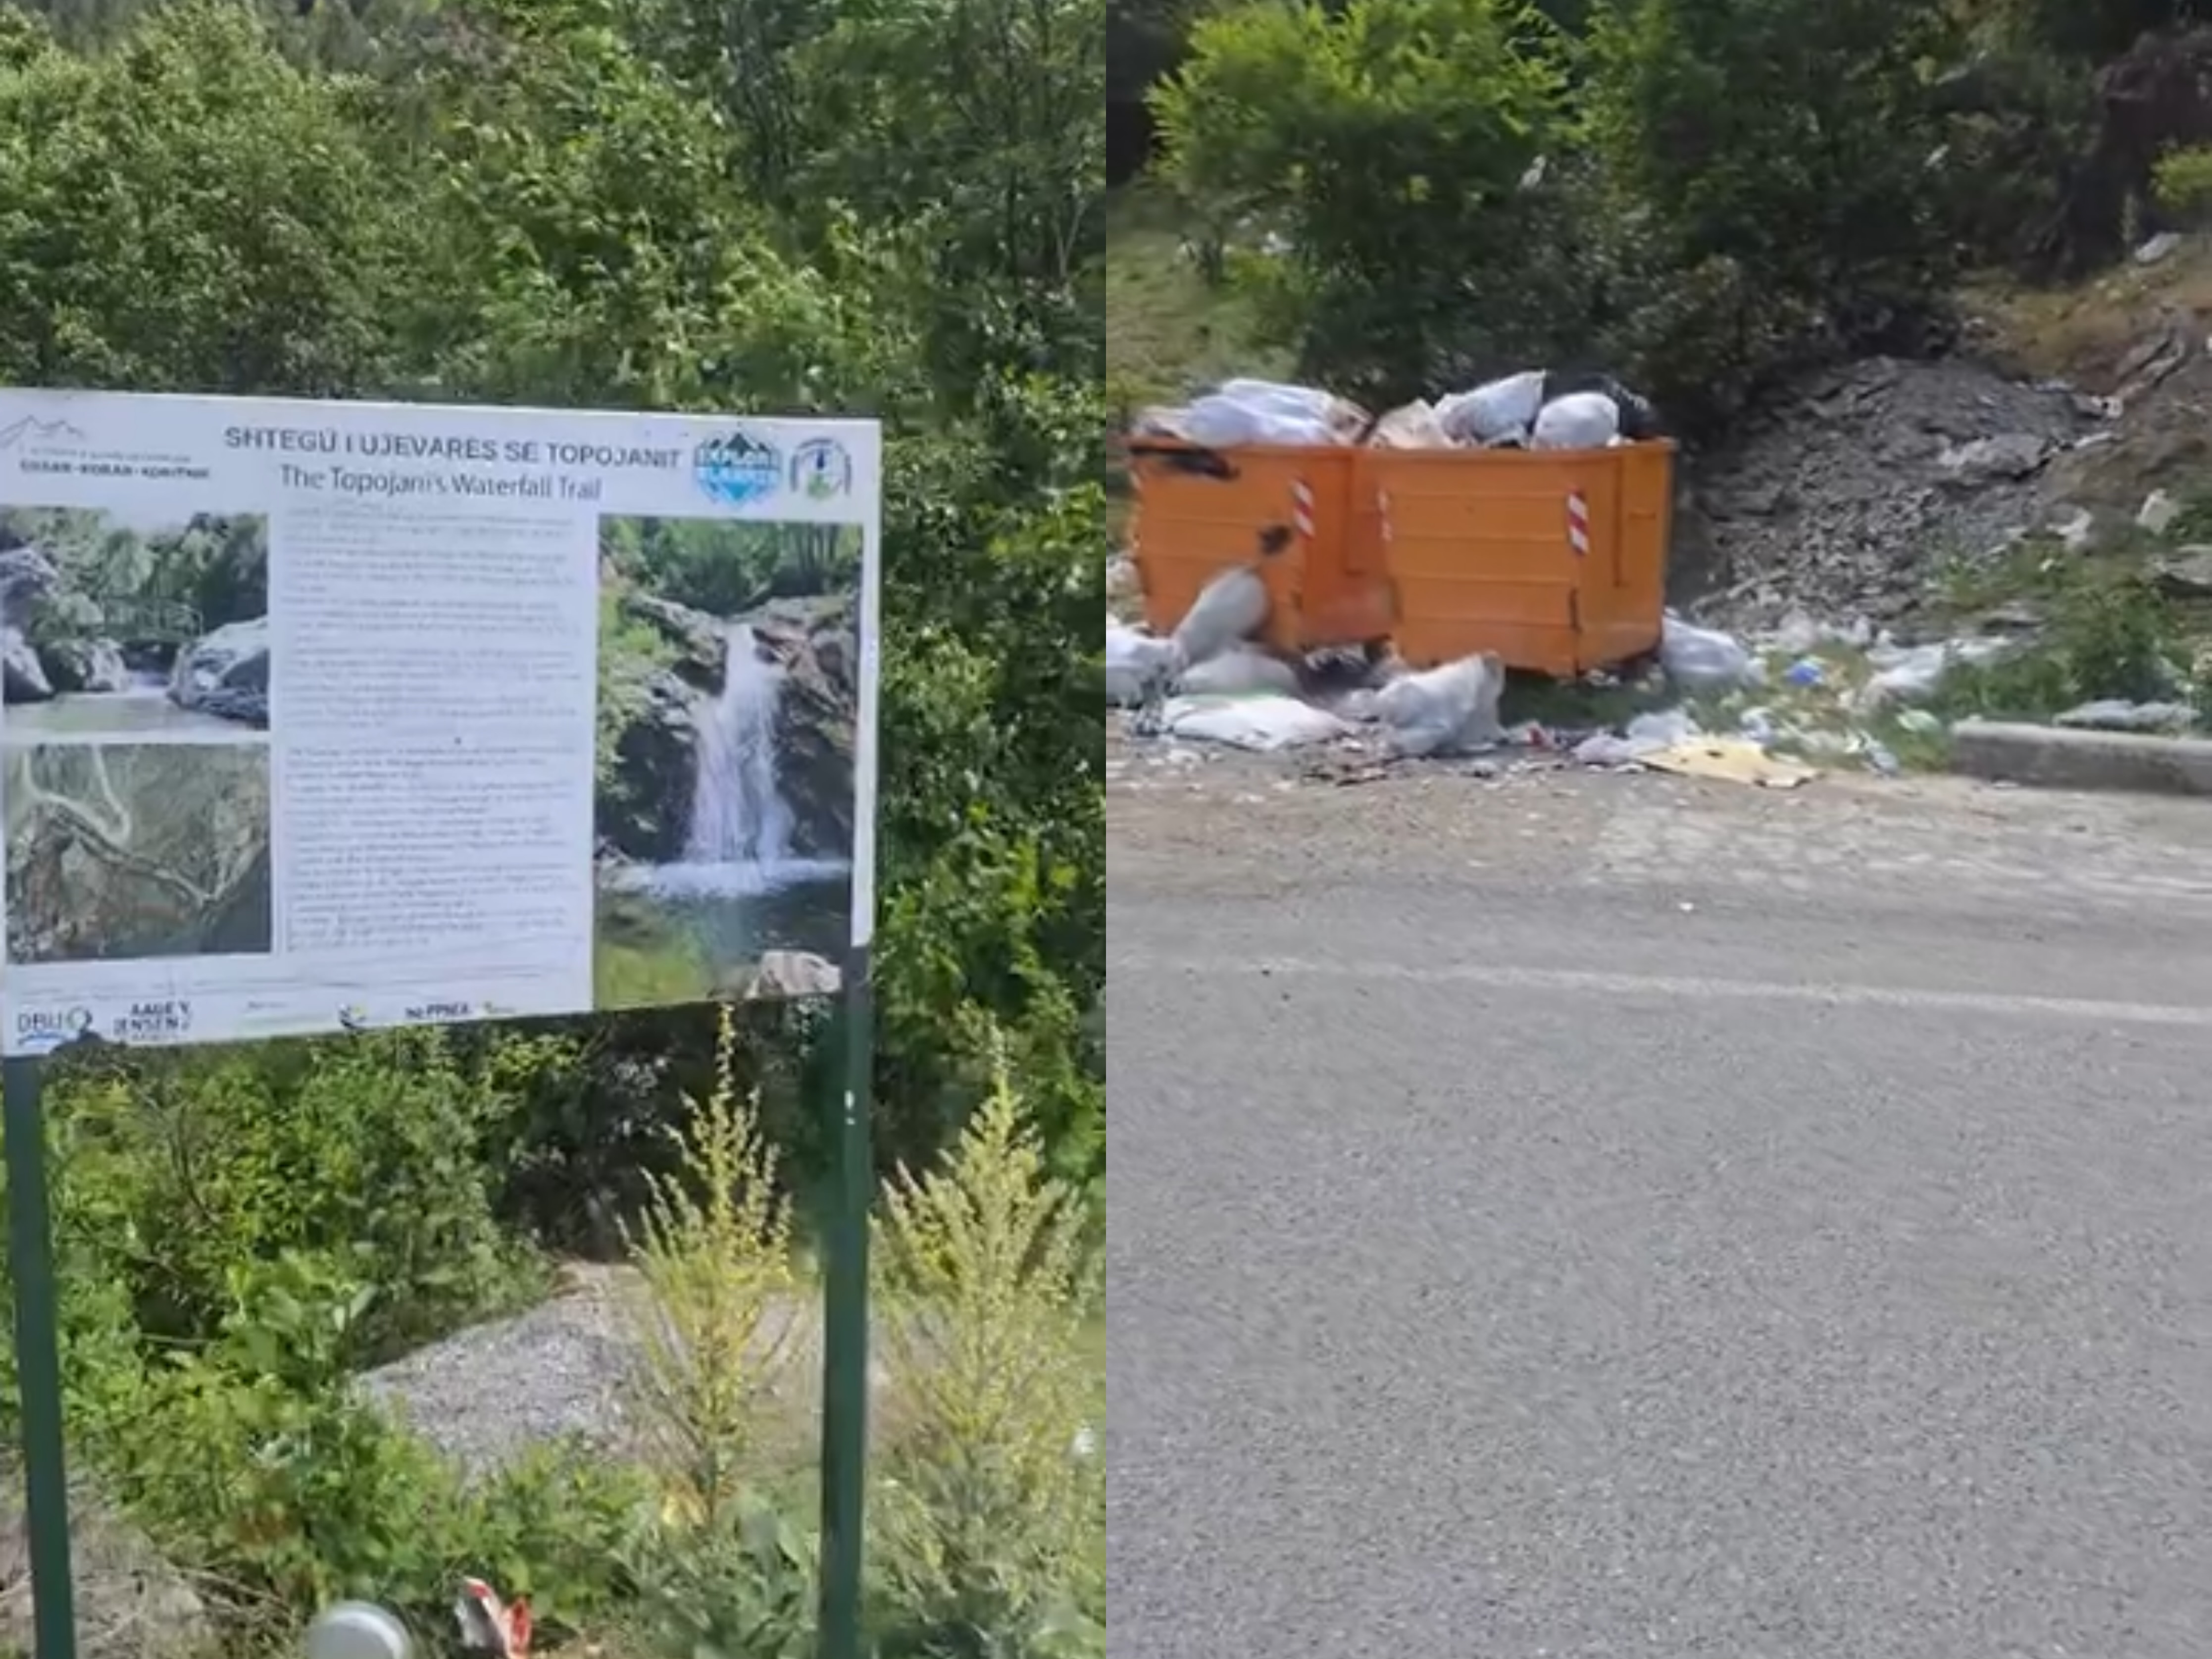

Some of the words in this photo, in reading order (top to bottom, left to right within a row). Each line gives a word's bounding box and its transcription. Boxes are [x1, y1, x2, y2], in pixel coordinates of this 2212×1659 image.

[225, 427, 336, 452] SHTEGU
[346, 435, 352, 453] I
[546, 443, 681, 468] TOPOJANIT
[281, 464, 325, 489] The
[331, 467, 447, 497] Topojani's
[451, 472, 551, 498] Waterfall
[559, 475, 602, 500] Trail
